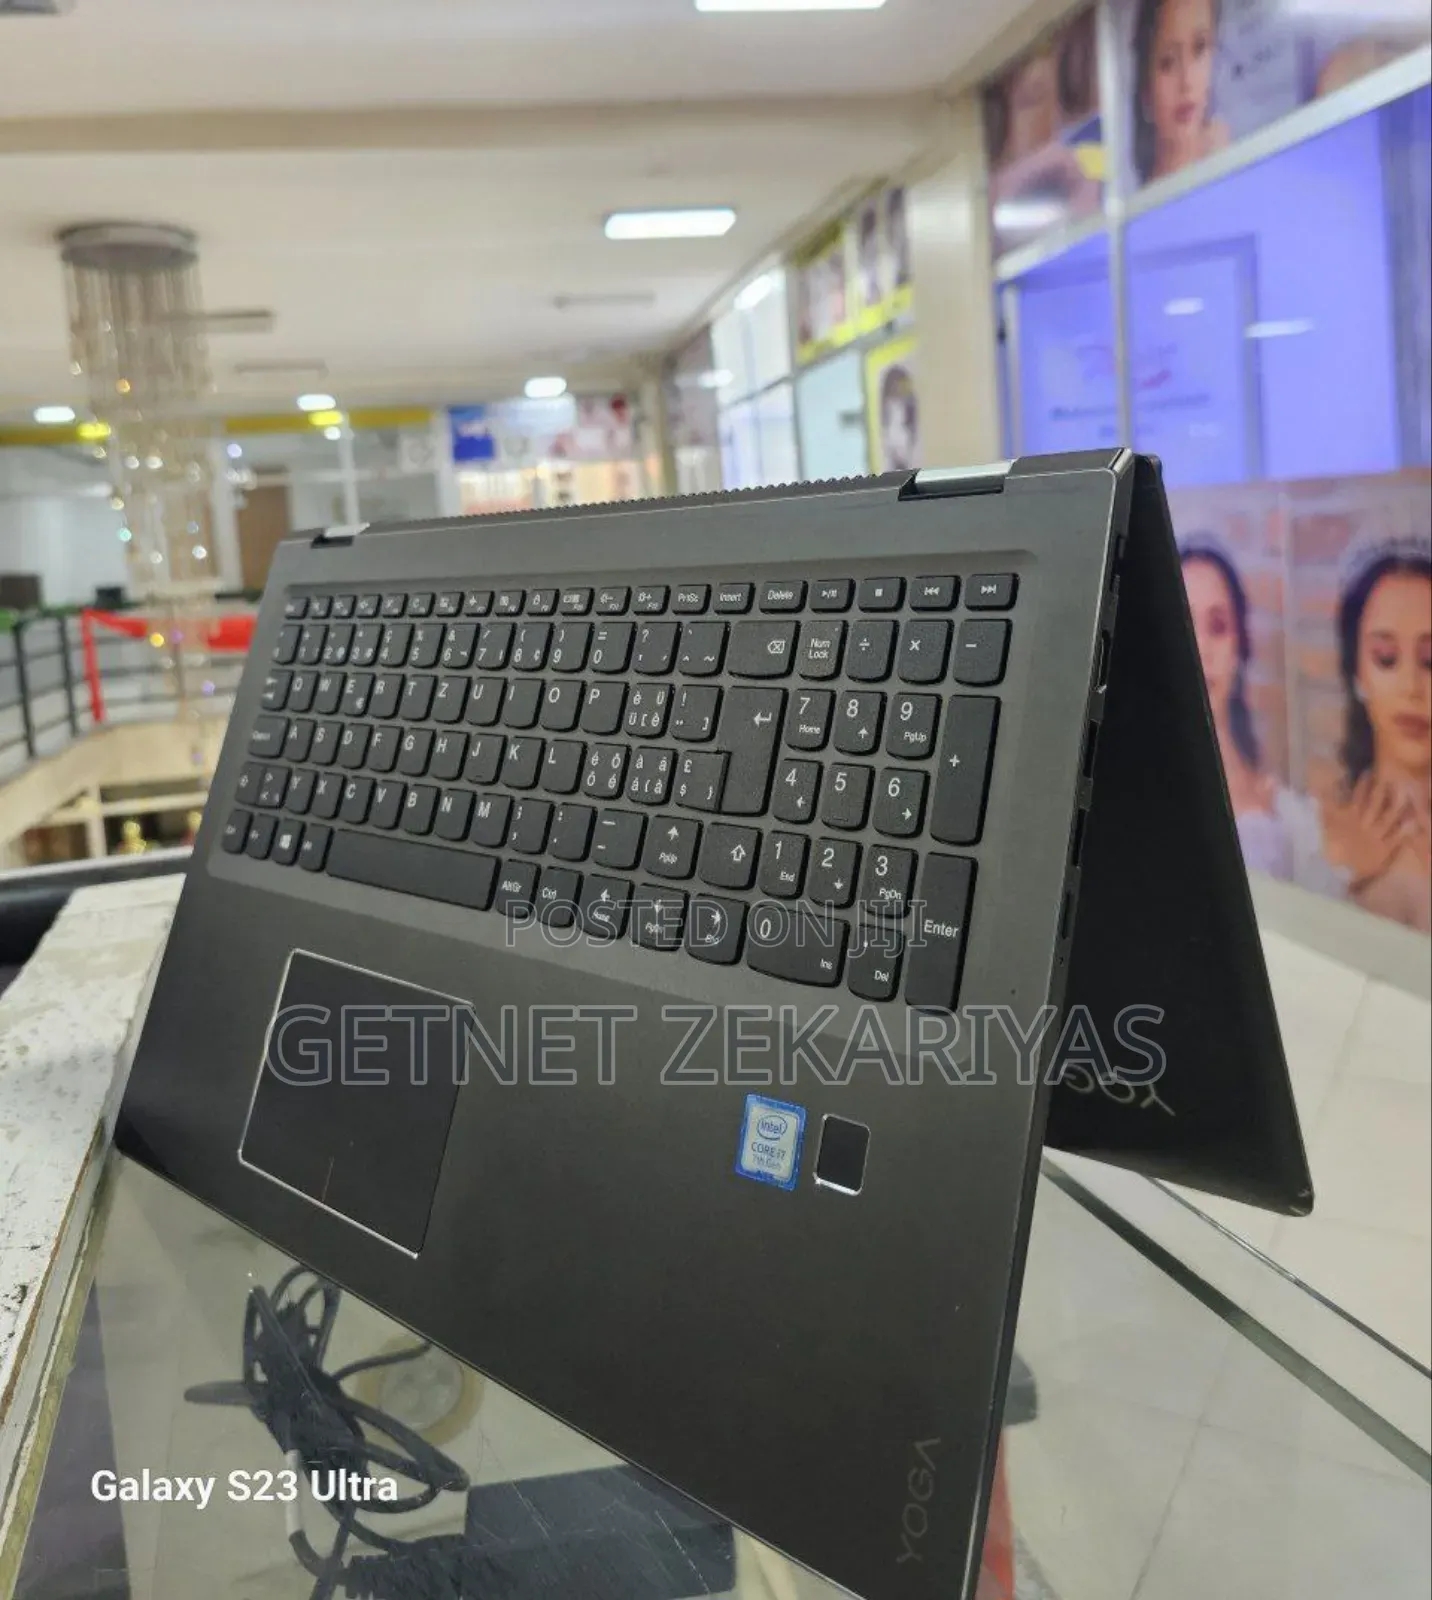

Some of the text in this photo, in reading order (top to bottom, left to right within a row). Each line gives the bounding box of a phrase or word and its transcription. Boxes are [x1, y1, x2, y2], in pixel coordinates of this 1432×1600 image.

[720, 592, 742, 602] Insert
[768, 589, 793, 602] Delete
[643, 630, 650, 642] ?
[810, 637, 831, 649] Num
[443, 647, 453, 661] 6
[480, 648, 487, 661] 7
[514, 648, 523, 662] 8
[554, 649, 562, 662] 9
[593, 649, 603, 664] 0
[808, 649, 830, 661] Lock
[319, 679, 331, 692] W
[346, 680, 356, 694] E
[376, 680, 385, 695] R
[407, 681, 417, 696] T
[438, 682, 448, 698] Z
[474, 683, 484, 699] U
[508, 685, 515, 701] I
[548, 687, 560, 703] O
[589, 688, 600, 704] P
[799, 697, 811, 715] 7
[846, 699, 858, 717] 8
[900, 702, 913, 721] 9
[289, 726, 298, 740] A
[316, 727, 325, 743] S
[799, 724, 821, 735] Home
[904, 730, 927, 744] PgUp
[342, 730, 353, 745] D
[372, 732, 382, 747] F
[404, 736, 414, 751] G
[436, 738, 447, 754] H
[472, 741, 481, 757] J
[509, 744, 519, 760] K
[548, 748, 556, 764] L
[684, 759, 692, 773] £
[785, 767, 797, 786] 4
[834, 773, 847, 791] 5
[317, 780, 328, 795] X
[345, 783, 356, 799] C
[680, 783, 687, 797] $
[888, 777, 900, 797] 6
[377, 787, 386, 803] V
[407, 791, 417, 807] B
[441, 796, 453, 812] N
[478, 801, 491, 818] M
[775, 841, 782, 859] 1
[822, 848, 834, 867] 2
[876, 855, 888, 876] 3
[780, 870, 796, 882] End
[502, 881, 522, 892] AltGr
[542, 887, 557, 899] Ctrl
[879, 887, 901, 900] PgDn
[760, 918, 772, 940] 0
[923, 919, 959, 939] Enter
[820, 958, 833, 969] Ins
[874, 970, 889, 982] Del
[760, 1118, 782, 1136] intel
[751, 1141, 775, 1157] CORE
[896, 1437, 941, 1562] YOGA
